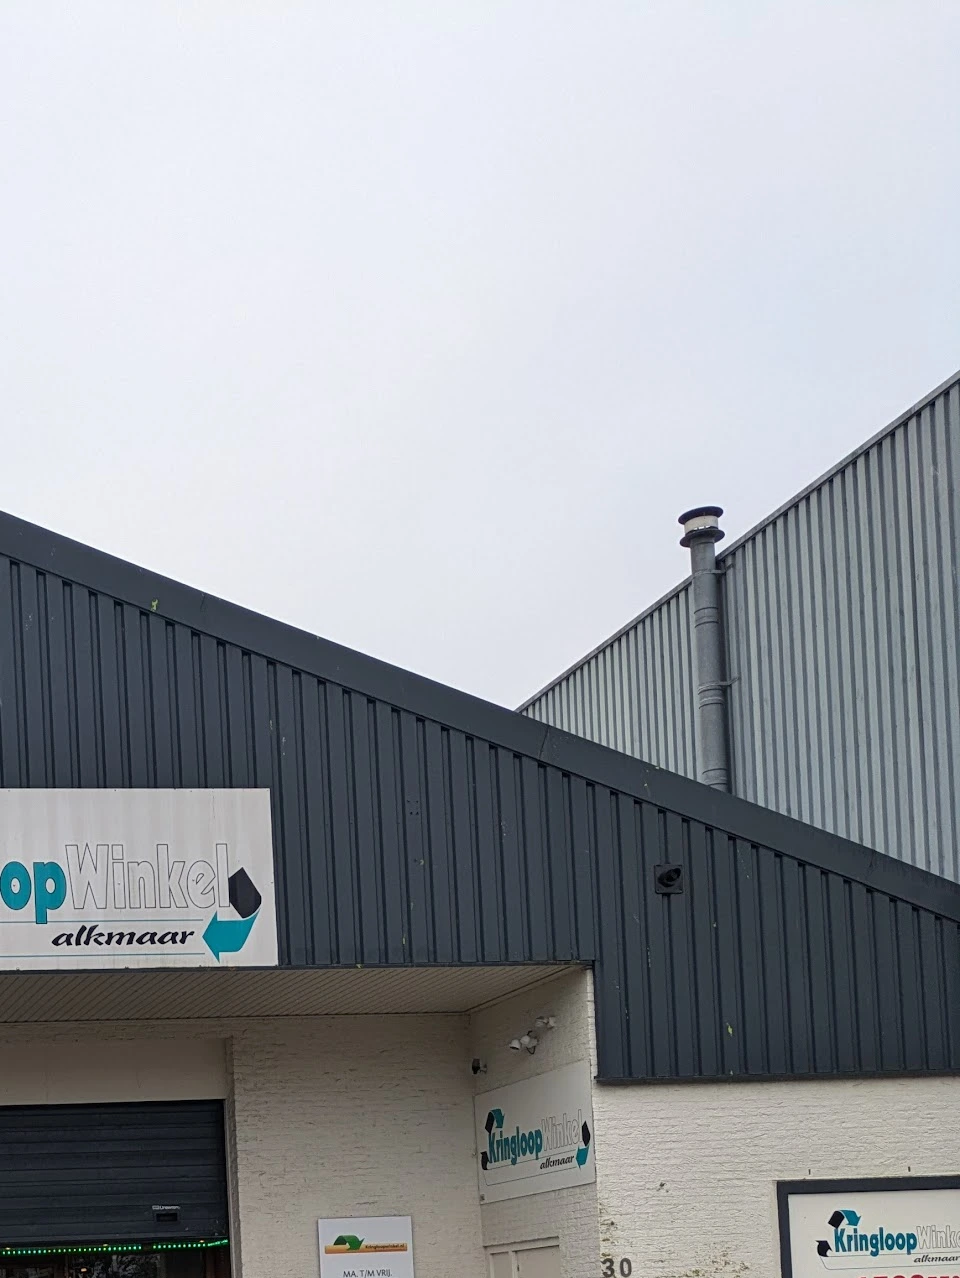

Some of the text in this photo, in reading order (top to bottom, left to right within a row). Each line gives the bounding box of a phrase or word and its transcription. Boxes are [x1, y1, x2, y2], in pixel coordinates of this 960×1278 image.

[51, 925, 195, 948] alkmaar
[539, 1154, 575, 1170] alkmaar
[913, 1254, 960, 1263] alkmaar
[343, 1269, 392, 1278] MA. T/M VRIJ.
[601, 1257, 633, 1278] 30
